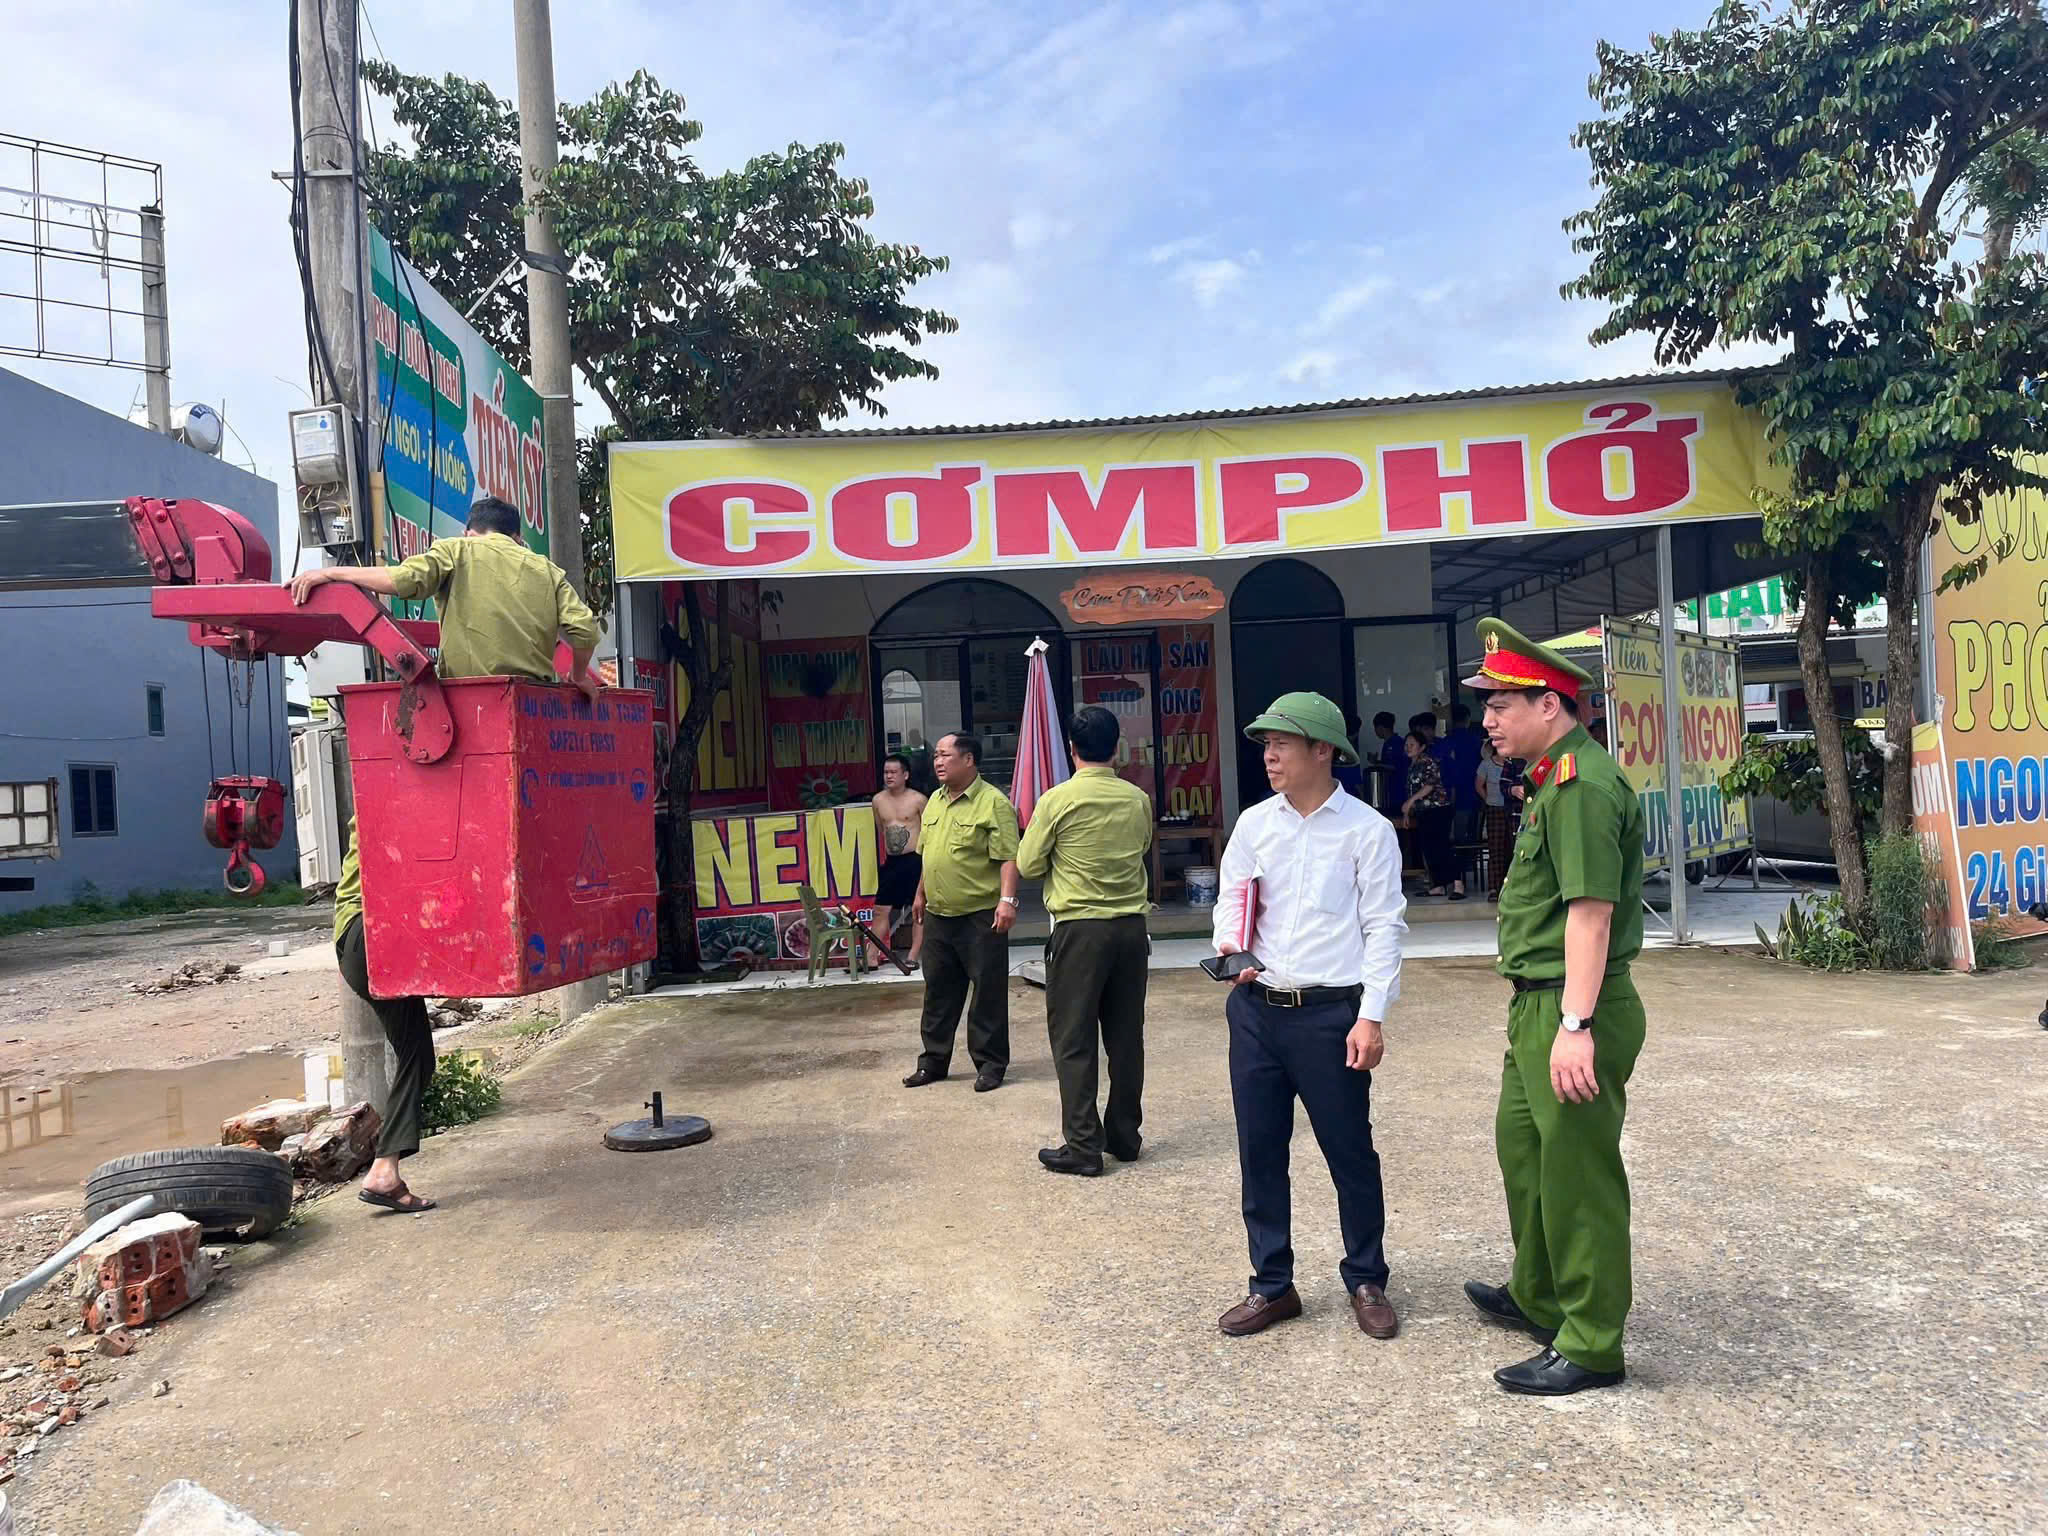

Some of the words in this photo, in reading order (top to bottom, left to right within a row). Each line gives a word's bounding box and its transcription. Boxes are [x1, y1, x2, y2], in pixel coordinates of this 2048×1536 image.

[1168, 631, 1211, 670] SẢN
[1158, 677, 1205, 718] ỐNG
[1681, 703, 1740, 762] NGON
[1639, 776, 1671, 857] ÚN
[1910, 760, 1945, 817] ƠM
[1953, 756, 2048, 829] NGO
[690, 806, 879, 910] NEM
[1967, 850, 2010, 922] 24
[2013, 843, 2048, 915] Gi
